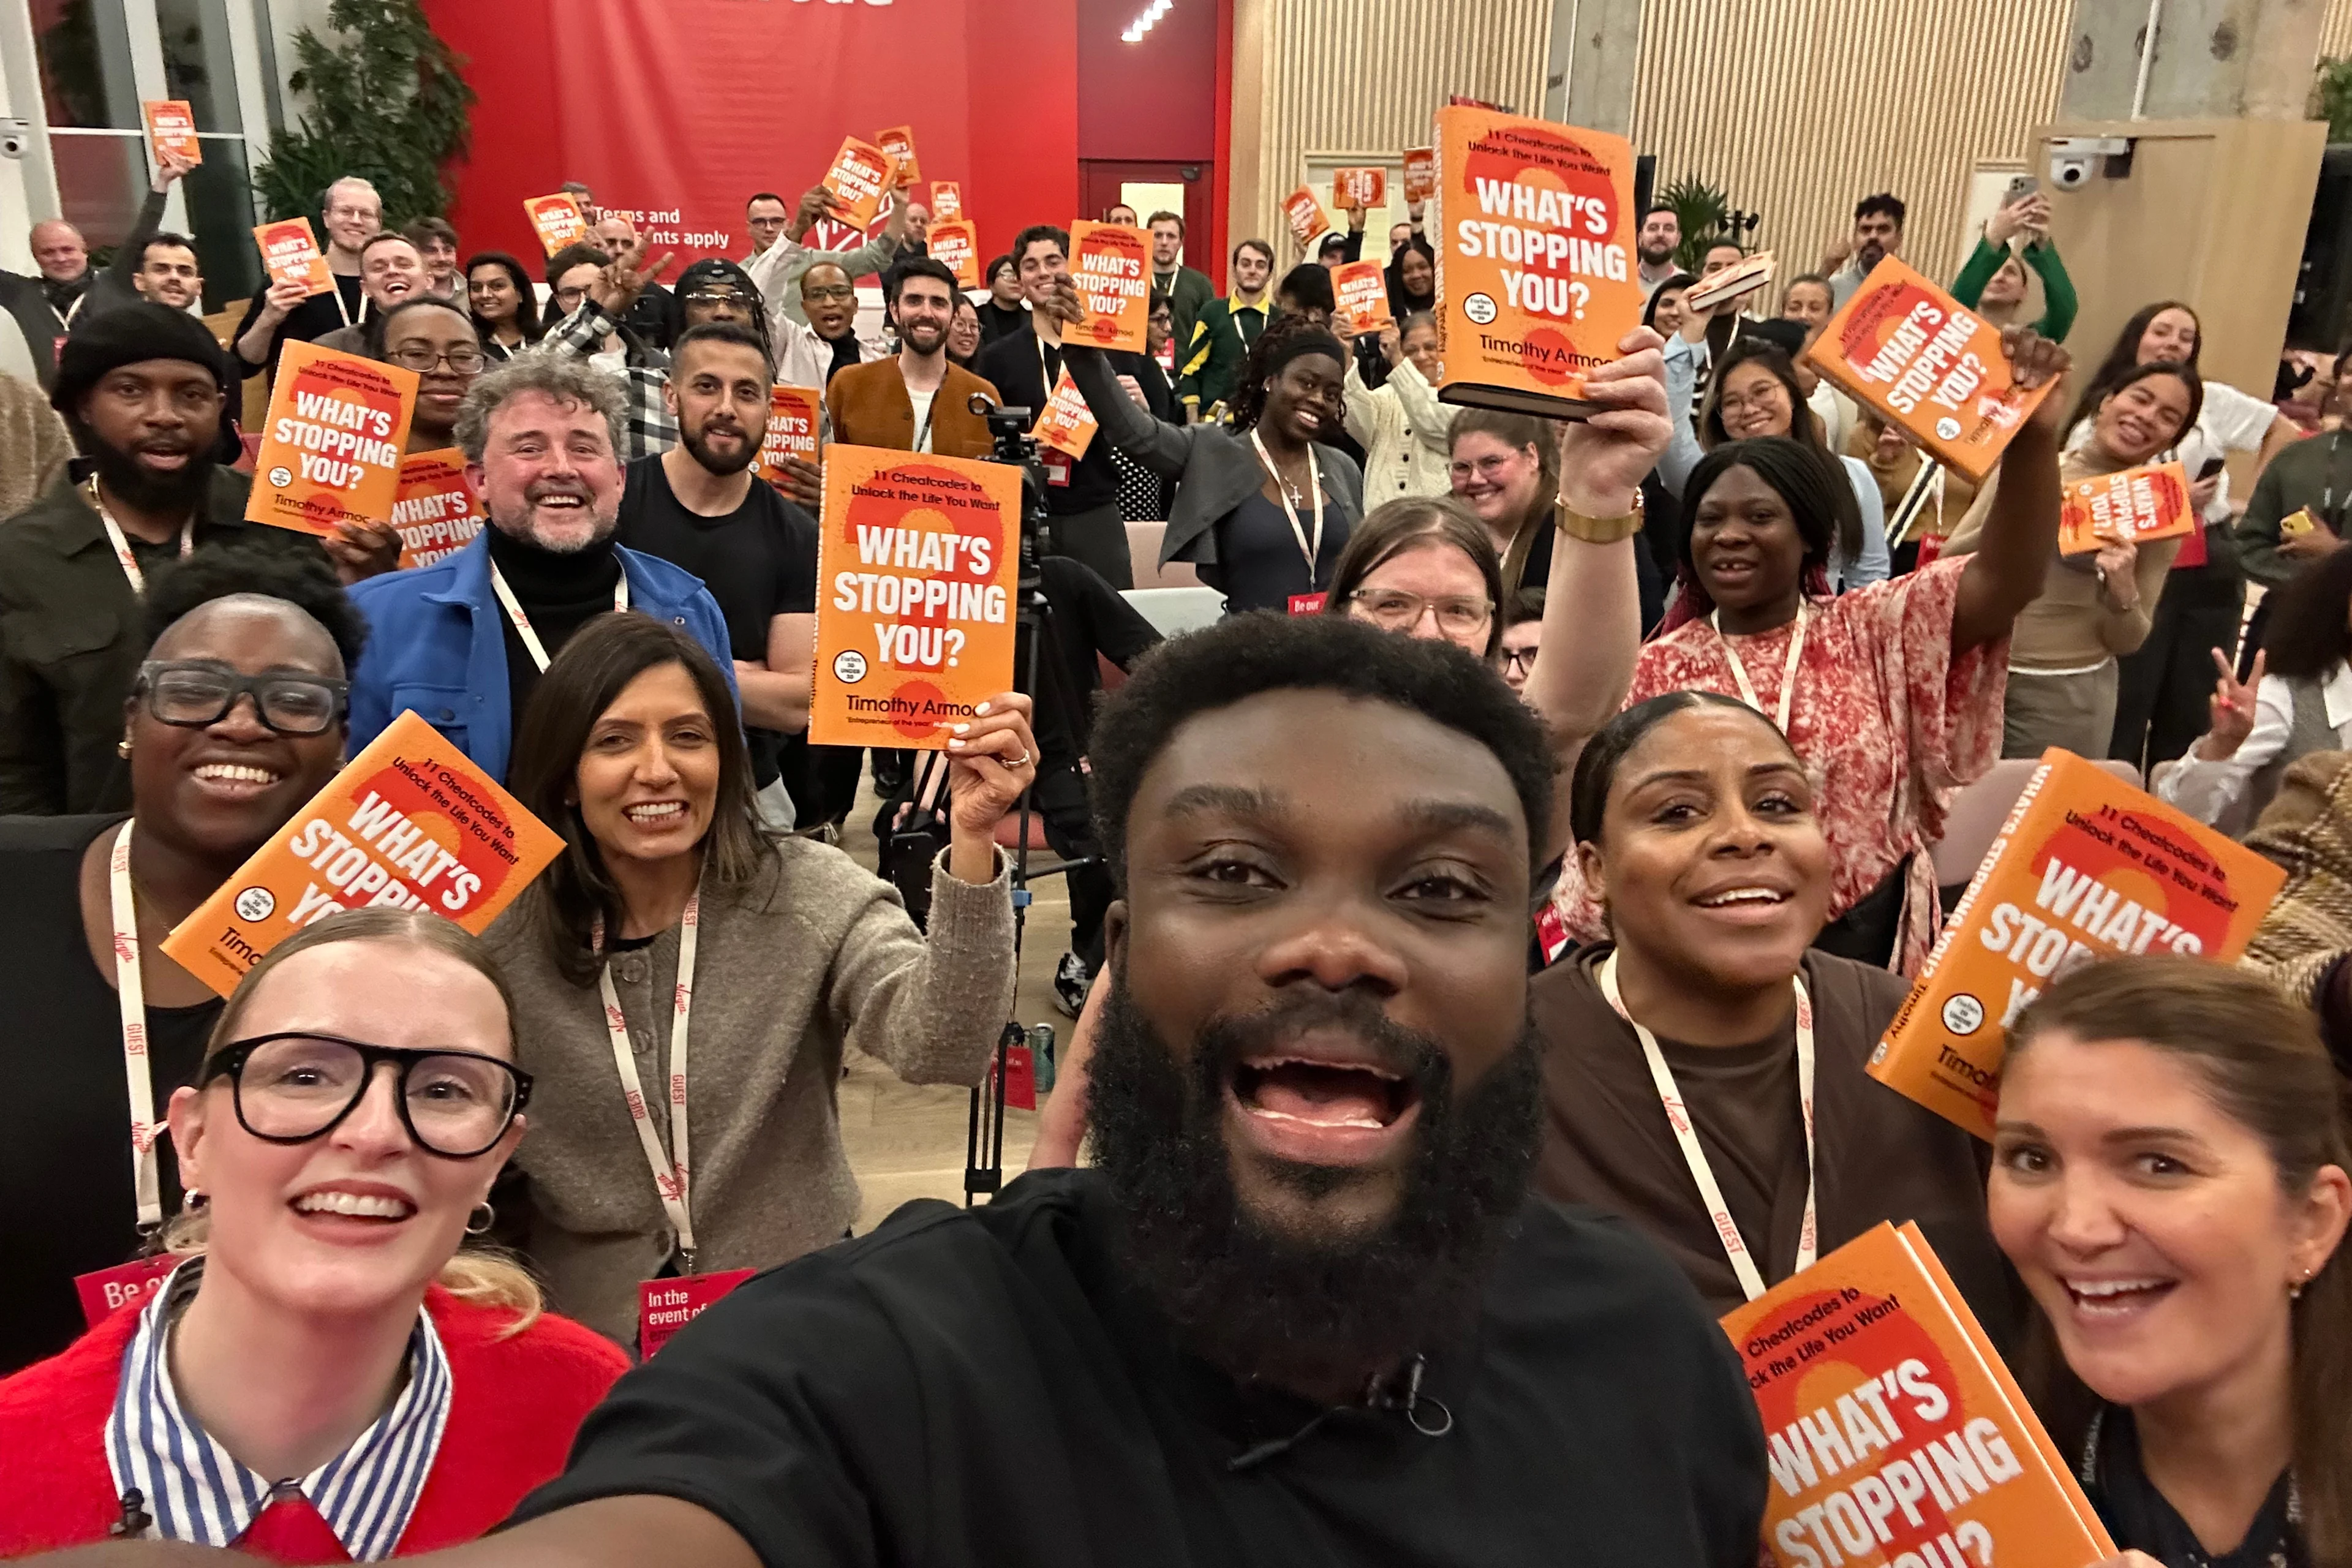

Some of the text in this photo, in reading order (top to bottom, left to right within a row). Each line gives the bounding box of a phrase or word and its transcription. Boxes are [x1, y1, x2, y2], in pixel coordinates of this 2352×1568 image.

[1468, 140, 1509, 158] Unlock
[830, 167, 881, 198] STOPPING
[842, 157, 882, 184] WHAT'S
[837, 183, 864, 203] YOU?
[1475, 176, 1608, 236] WHAT'S
[649, 209, 680, 224] and
[684, 230, 729, 249] apply
[930, 247, 973, 261] STOPPING
[933, 238, 967, 251] WHAT'S
[1458, 219, 1627, 283] STOPPING
[948, 260, 964, 271] OU?
[1082, 252, 1140, 277] WHAT'S
[1072, 272, 1146, 298] STOPPING
[1340, 276, 1378, 294] WHAT'S
[1499, 268, 1591, 320] YOU?
[1087, 294, 1127, 315] YOU?
[1479, 334, 1550, 363] Timothy
[1866, 301, 1942, 383] WHAT'S
[1886, 311, 1978, 415] STOPPING
[1060, 385, 1087, 407] WHA
[1930, 352, 1988, 412] YOU?
[297, 391, 393, 437] WHAT'S
[767, 415, 809, 434] HAT'S
[1049, 395, 1095, 424] STOPPING
[1054, 411, 1080, 431] YOU?
[274, 418, 398, 469] STOPPING
[763, 432, 815, 452] OPPING
[300, 452, 364, 490] YOU?
[874, 469, 982, 492] 11 Cheatcodes to
[275, 494, 326, 514] Timothy
[391, 491, 469, 525] WHAT'S
[851, 484, 1001, 511] Unlock the Life You Want
[396, 515, 485, 551] TOPPING
[411, 545, 466, 569] YO
[856, 524, 992, 576] WHAT'S
[832, 571, 1008, 624] STOPPING
[873, 622, 966, 668] YOU?
[846, 695, 921, 718] Timothy
[392, 756, 521, 866] Unlock the Life You Want
[423, 758, 516, 839] 11 Cheatcodes to
[2100, 804, 2118, 821] 11
[347, 790, 482, 911] WHAT'S
[289, 818, 439, 916] STOPP
[286, 881, 346, 927] YO
[219, 926, 264, 967] Timo
[675, 983, 692, 1015] Virgin
[1798, 993, 1811, 1031] GUEST
[126, 1023, 145, 1056] GUEST
[1938, 1043, 1989, 1086] Timo
[627, 1090, 646, 1120] GUEST
[672, 1074, 685, 1106] GUEST
[1714, 1211, 1745, 1254] GUEST
[103, 1281, 140, 1309] Be
[648, 1289, 689, 1308] In the
[649, 1303, 707, 1326] event of
[1747, 1287, 1860, 1359] Cheatcodes to
[1768, 1293, 1902, 1378] the Life You Want
[1768, 1358, 1950, 1498] WHAT'S
[1775, 1416, 2024, 1568] STOPPING
[1878, 1520, 1993, 1568] OU?
